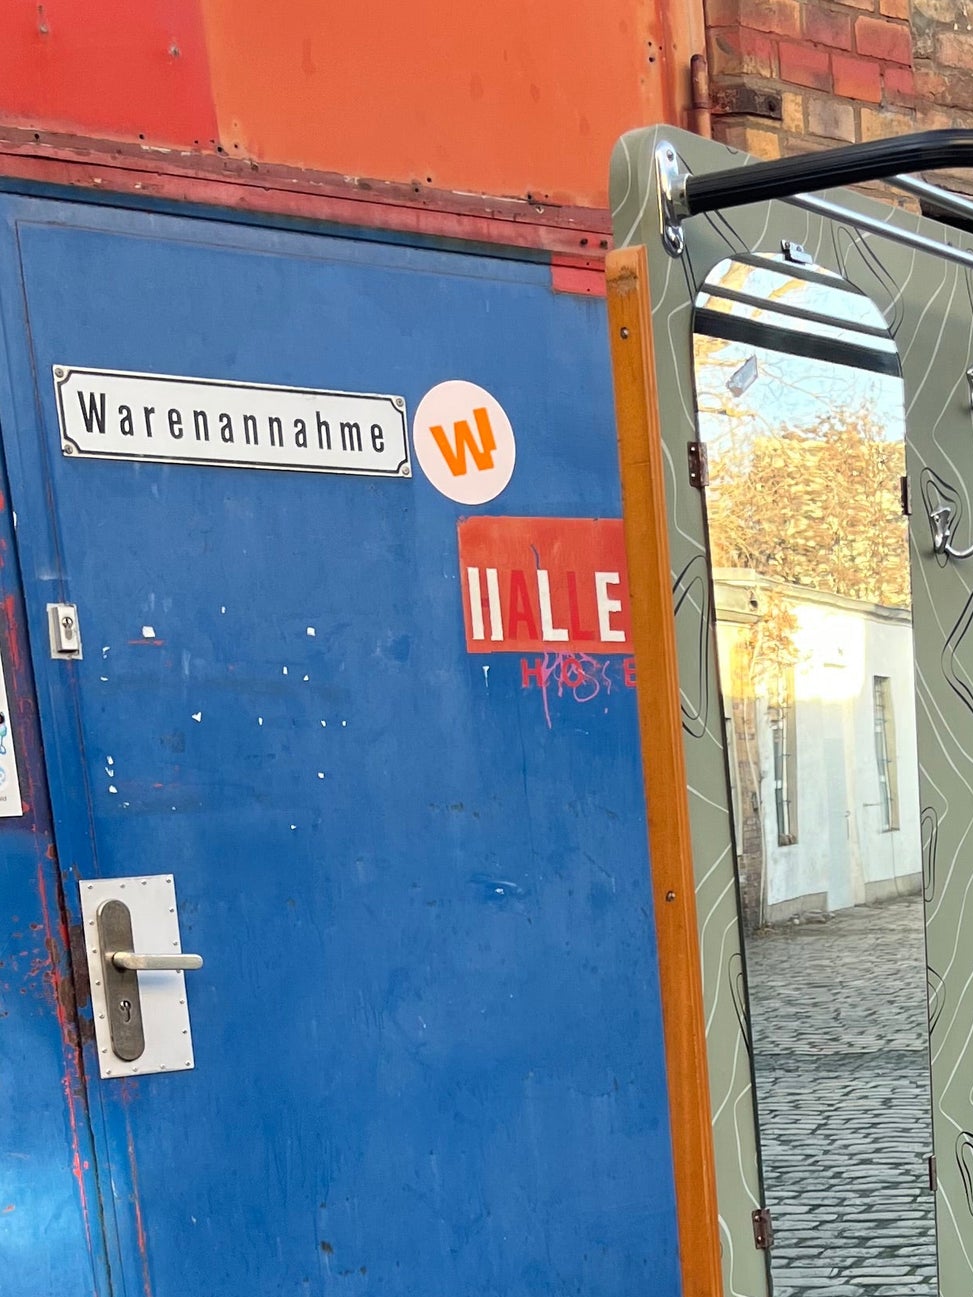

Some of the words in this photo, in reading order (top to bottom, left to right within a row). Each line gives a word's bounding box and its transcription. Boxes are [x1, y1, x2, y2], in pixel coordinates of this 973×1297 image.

[77, 390, 386, 454] Warenannahme
[430, 407, 498, 477] W
[467, 567, 627, 642] HALLE
